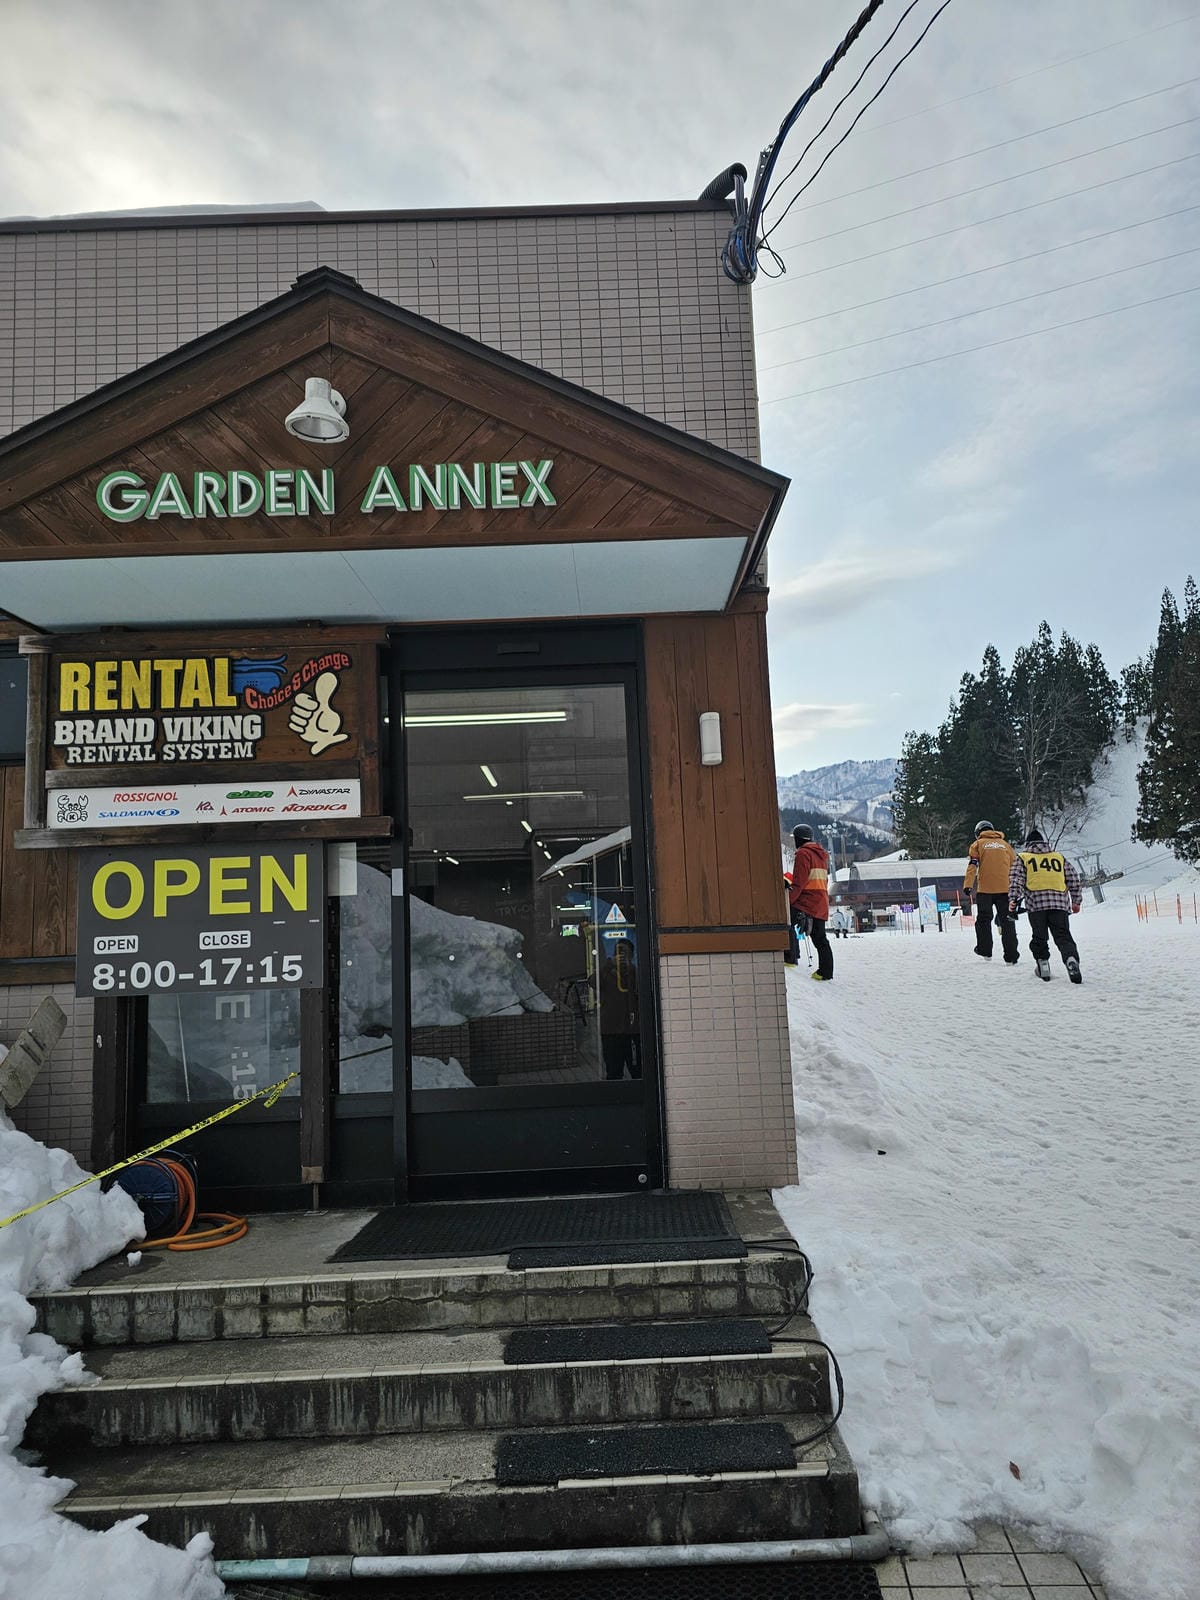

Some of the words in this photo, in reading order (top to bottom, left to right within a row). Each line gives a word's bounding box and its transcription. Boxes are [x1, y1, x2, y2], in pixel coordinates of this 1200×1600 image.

[95, 467, 336, 523] GARDEN
[360, 459, 558, 513] ANNEX
[60, 658, 237, 711] RENTAL
[245, 687, 292, 709] Choice
[302, 653, 349, 682] Change
[53, 718, 156, 746] BRAND
[161, 714, 263, 742] VIKING
[67, 745, 156, 764] RENTAL
[163, 741, 254, 761] SYSTEM
[113, 792, 178, 803] ROSSIGNOL
[299, 788, 351, 796] DYNASTAR
[98, 810, 156, 818] SALOMON
[281, 803, 347, 812] NORDICA
[1027, 857, 1062, 872] 140
[91, 853, 308, 920] OPEN
[96, 938, 137, 952] OPEN
[202, 933, 249, 947] CLOSE
[92, 954, 304, 991] 8:00-17:15
